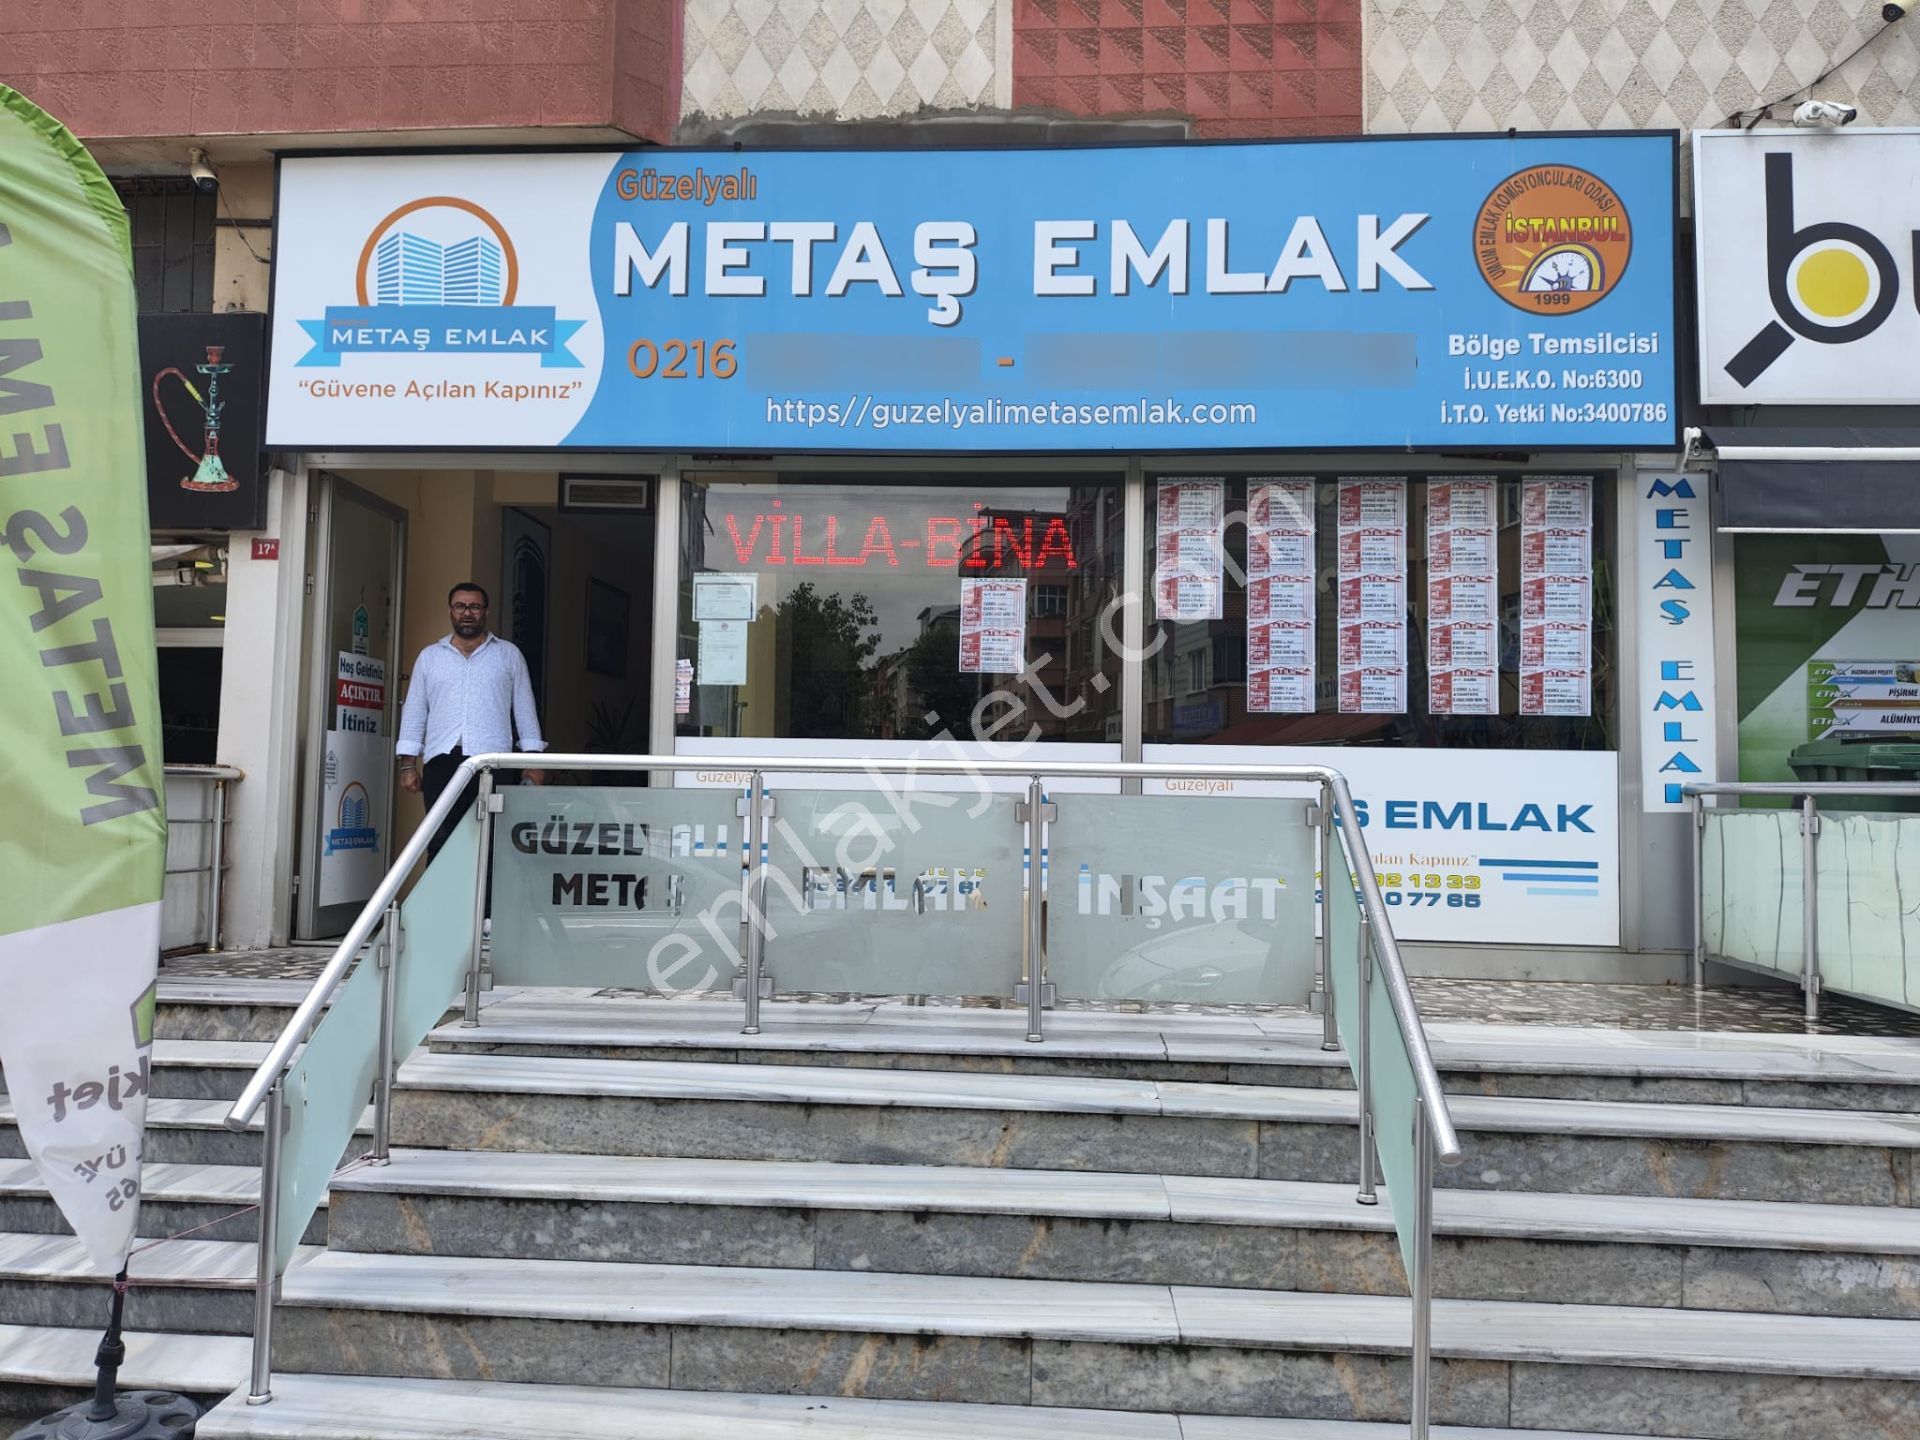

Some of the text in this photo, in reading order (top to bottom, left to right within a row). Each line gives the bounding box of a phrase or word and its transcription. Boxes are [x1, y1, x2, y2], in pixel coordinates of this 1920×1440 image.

[616, 167, 757, 206] Güzelyalı
[1480, 209, 1501, 247] EMLAK
[1584, 183, 1616, 212] ODASI
[1505, 211, 1626, 243] İSTANBUL
[1762, 153, 1920, 350] b
[613, 212, 1435, 326] METAŞ EMLAK
[1534, 293, 1571, 305] 1999
[332, 328, 550, 350] METAŞ EMLAK
[1449, 332, 1659, 360] Bölge Temsilcisi
[627, 338, 738, 379] 0216
[405, 380, 476, 401] Açılan
[1464, 367, 1643, 390] İ.U.E.K.O. No:6300
[766, 396, 1257, 429] https//guzelyalimetasemlak.com
[1441, 401, 1667, 424] İ.T.O. Yetki No:3400786
[725, 499, 1078, 569] VİLLA-BİNA
[1646, 478, 1696, 625] METAŞ
[1773, 563, 1920, 608] ETH
[340, 657, 384, 681] Hoş Geldiniz
[340, 681, 381, 703] AÇIKTIR
[1888, 688, 1918, 698] PİŞİRME
[341, 709, 377, 733] İtiniz
[1385, 800, 1596, 833] EMLAK
[1078, 863, 1287, 929] İNŞAAT
[1408, 874, 1442, 888] 13
[1446, 875, 1481, 889] 33
[1407, 892, 1442, 907] 77
